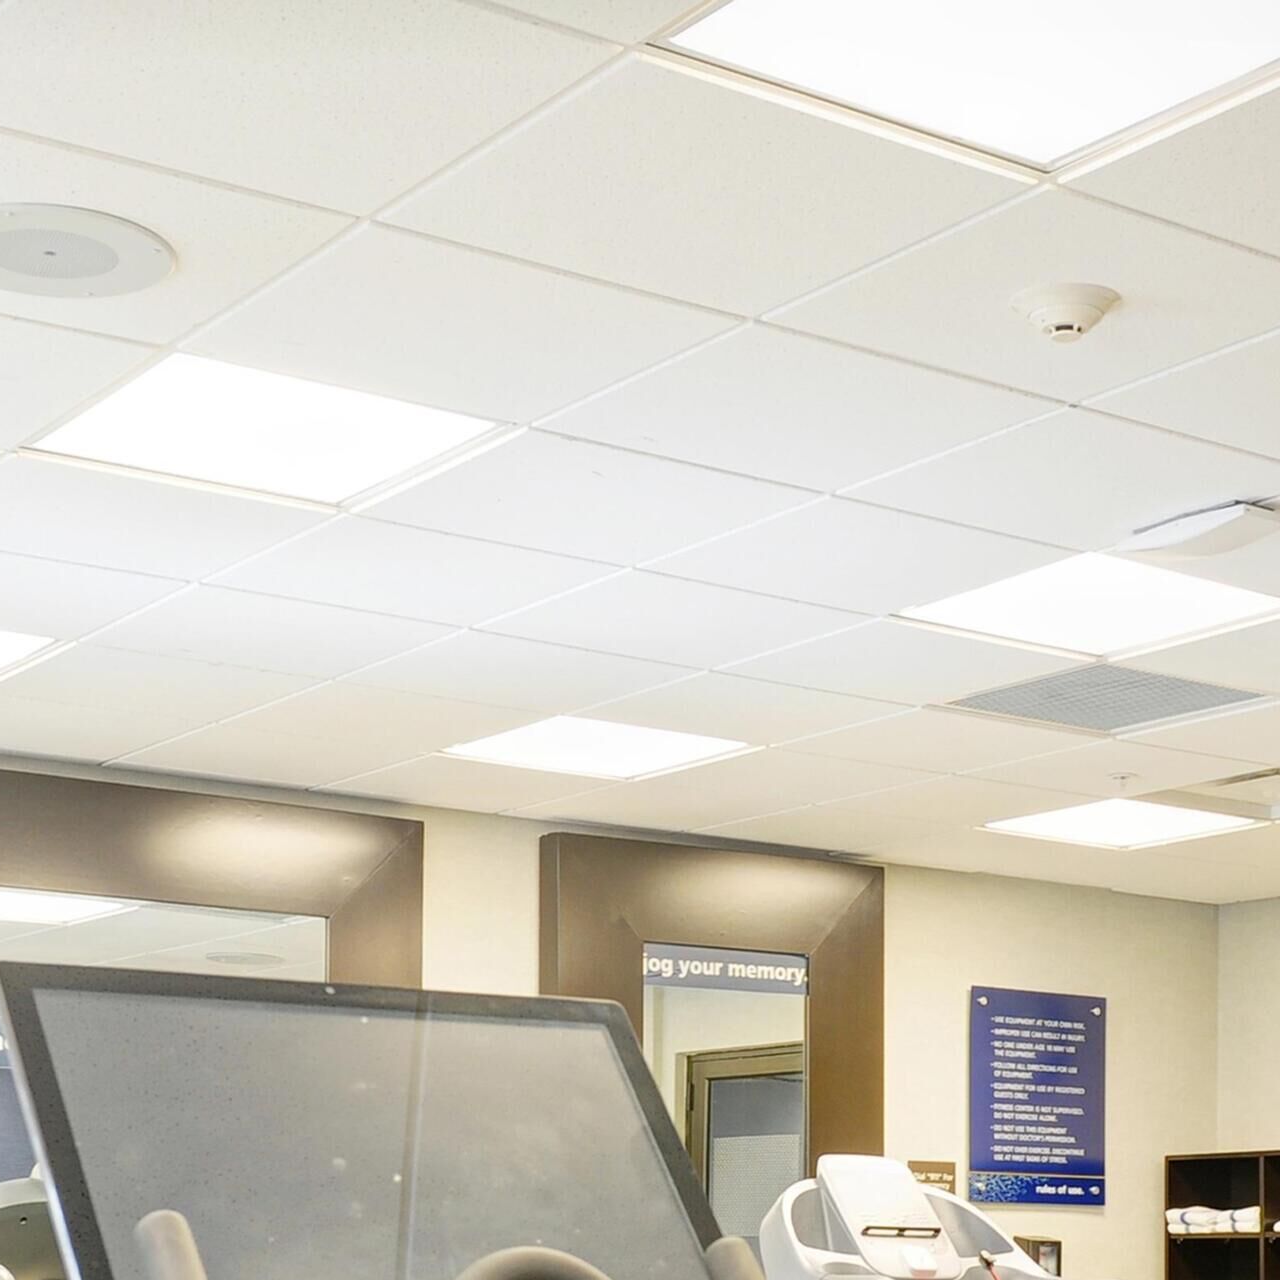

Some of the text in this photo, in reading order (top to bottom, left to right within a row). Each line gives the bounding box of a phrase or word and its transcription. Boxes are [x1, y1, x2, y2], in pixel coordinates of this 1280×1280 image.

[642, 953, 808, 986] jog your memory.
